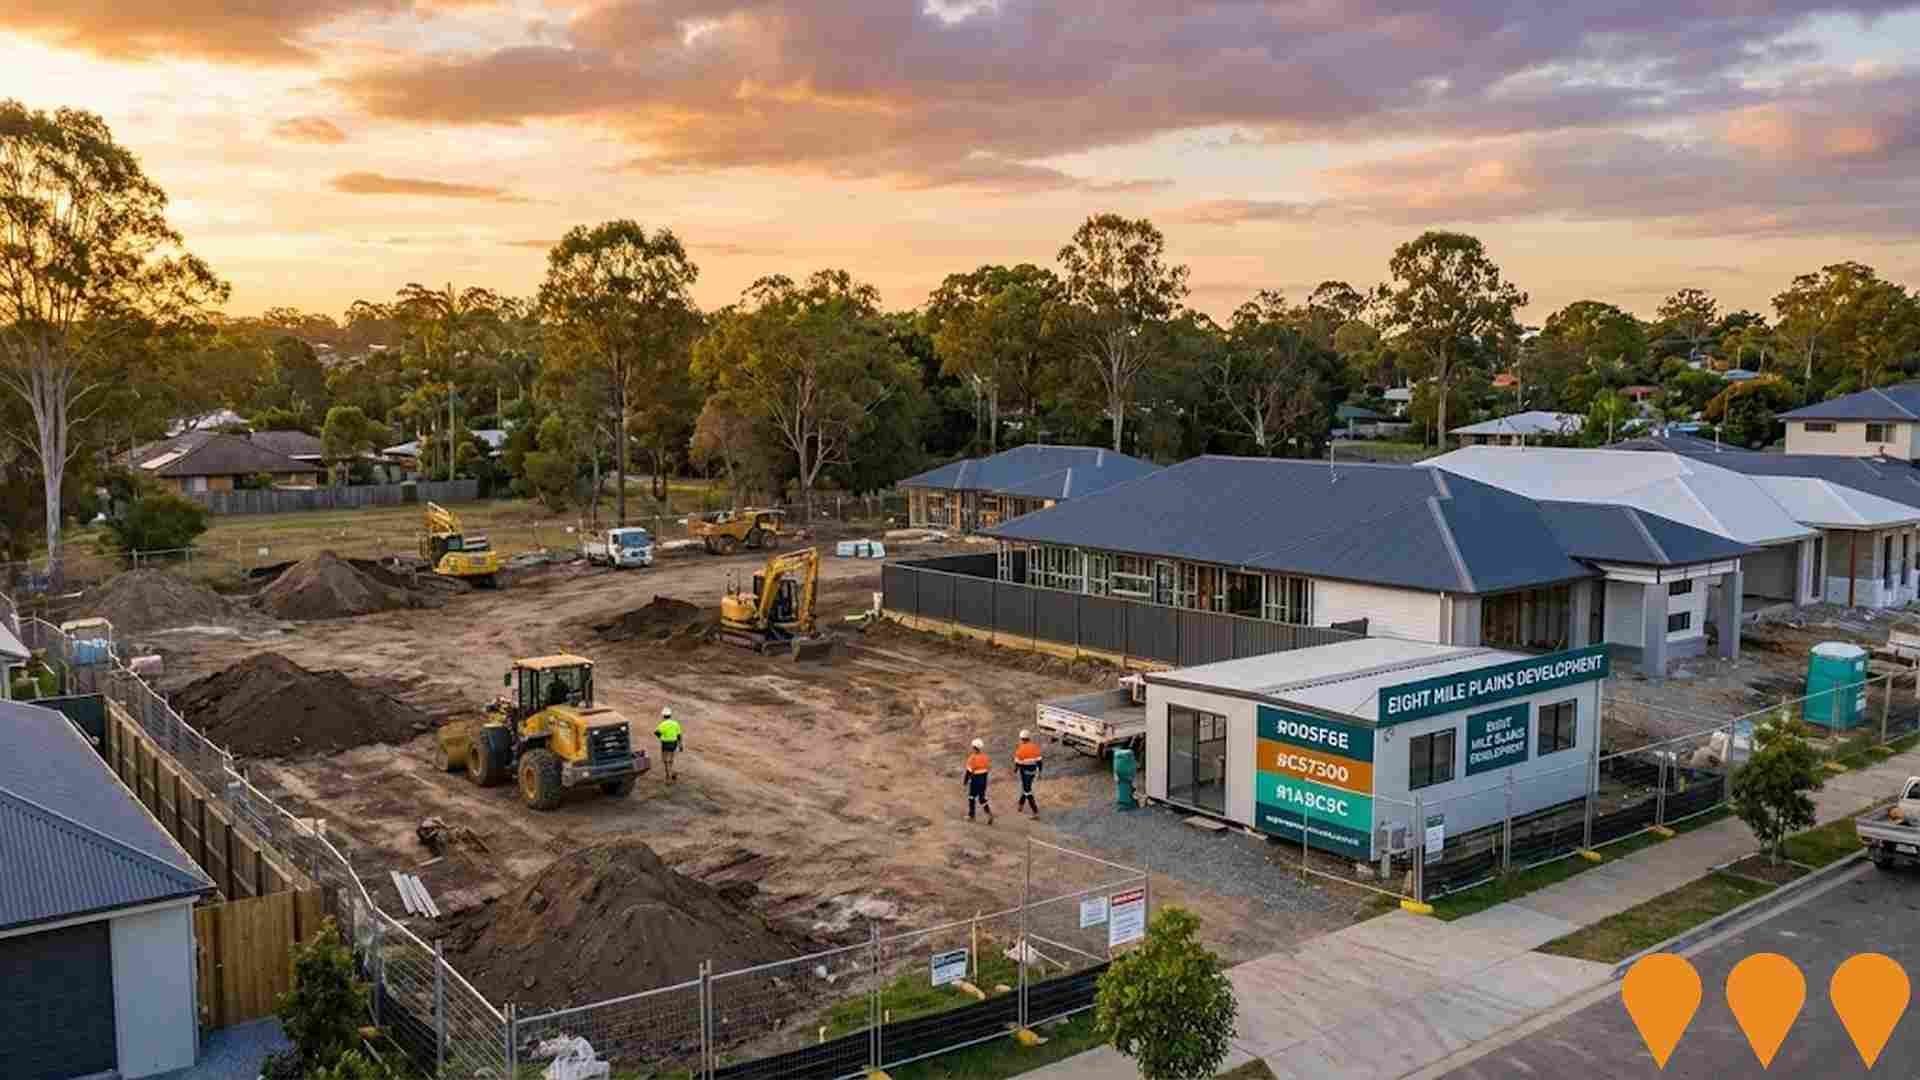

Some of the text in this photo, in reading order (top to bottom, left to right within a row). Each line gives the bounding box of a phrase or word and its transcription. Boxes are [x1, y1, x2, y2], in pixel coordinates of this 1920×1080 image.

[1388, 689, 1431, 714] EIGHT
[1434, 682, 1466, 705] MILE
[1469, 671, 1514, 697] PLAINS
